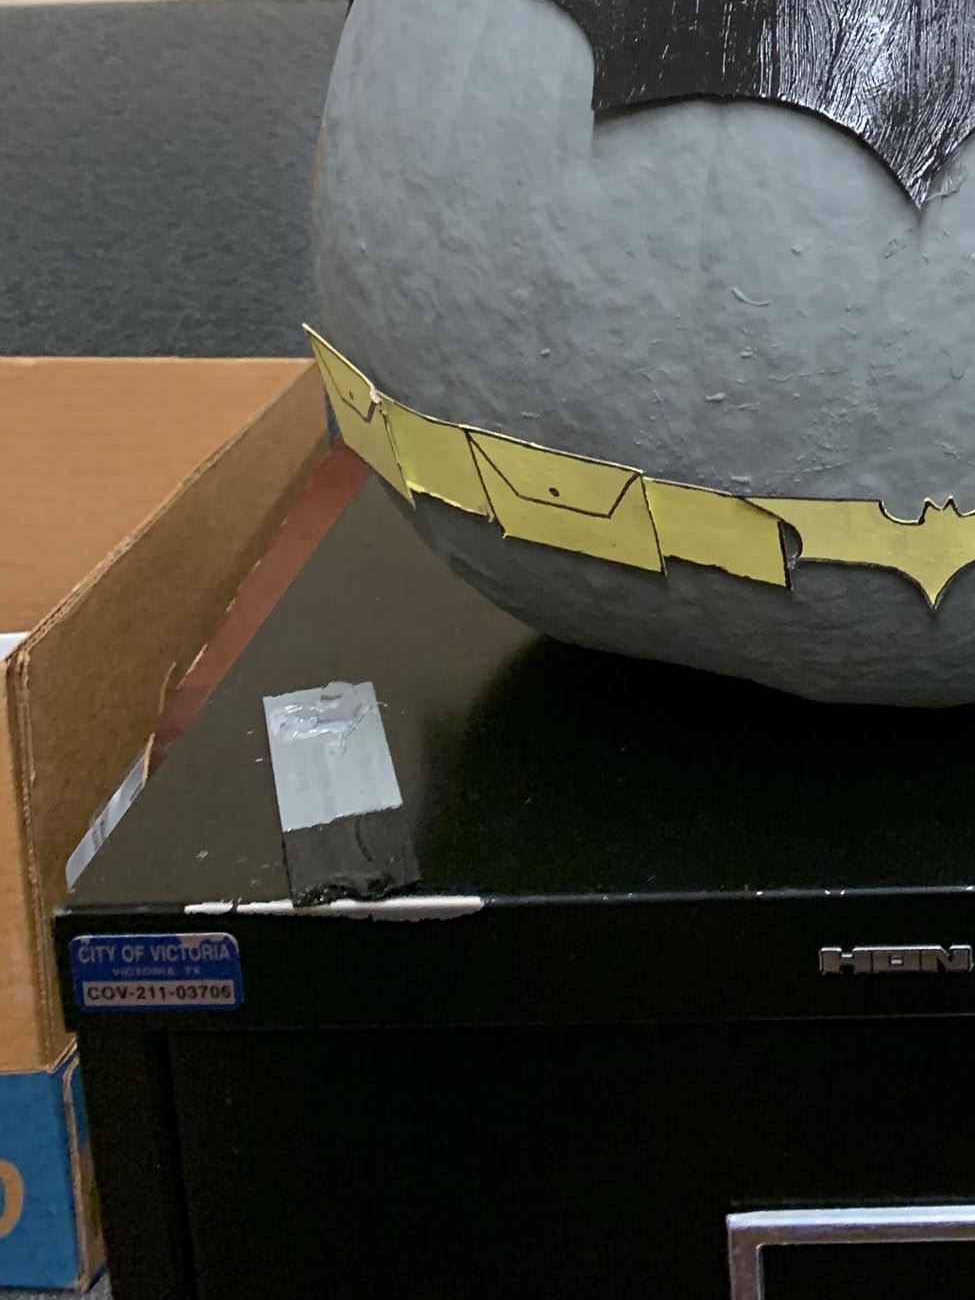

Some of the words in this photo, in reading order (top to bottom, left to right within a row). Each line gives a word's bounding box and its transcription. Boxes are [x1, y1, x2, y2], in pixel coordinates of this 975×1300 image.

[78, 945, 115, 963] CITY
[121, 944, 145, 962] OF
[150, 944, 229, 962] VICTORIA
[818, 945, 974, 973] HON
[87, 985, 231, 1001] COV-211-03706
